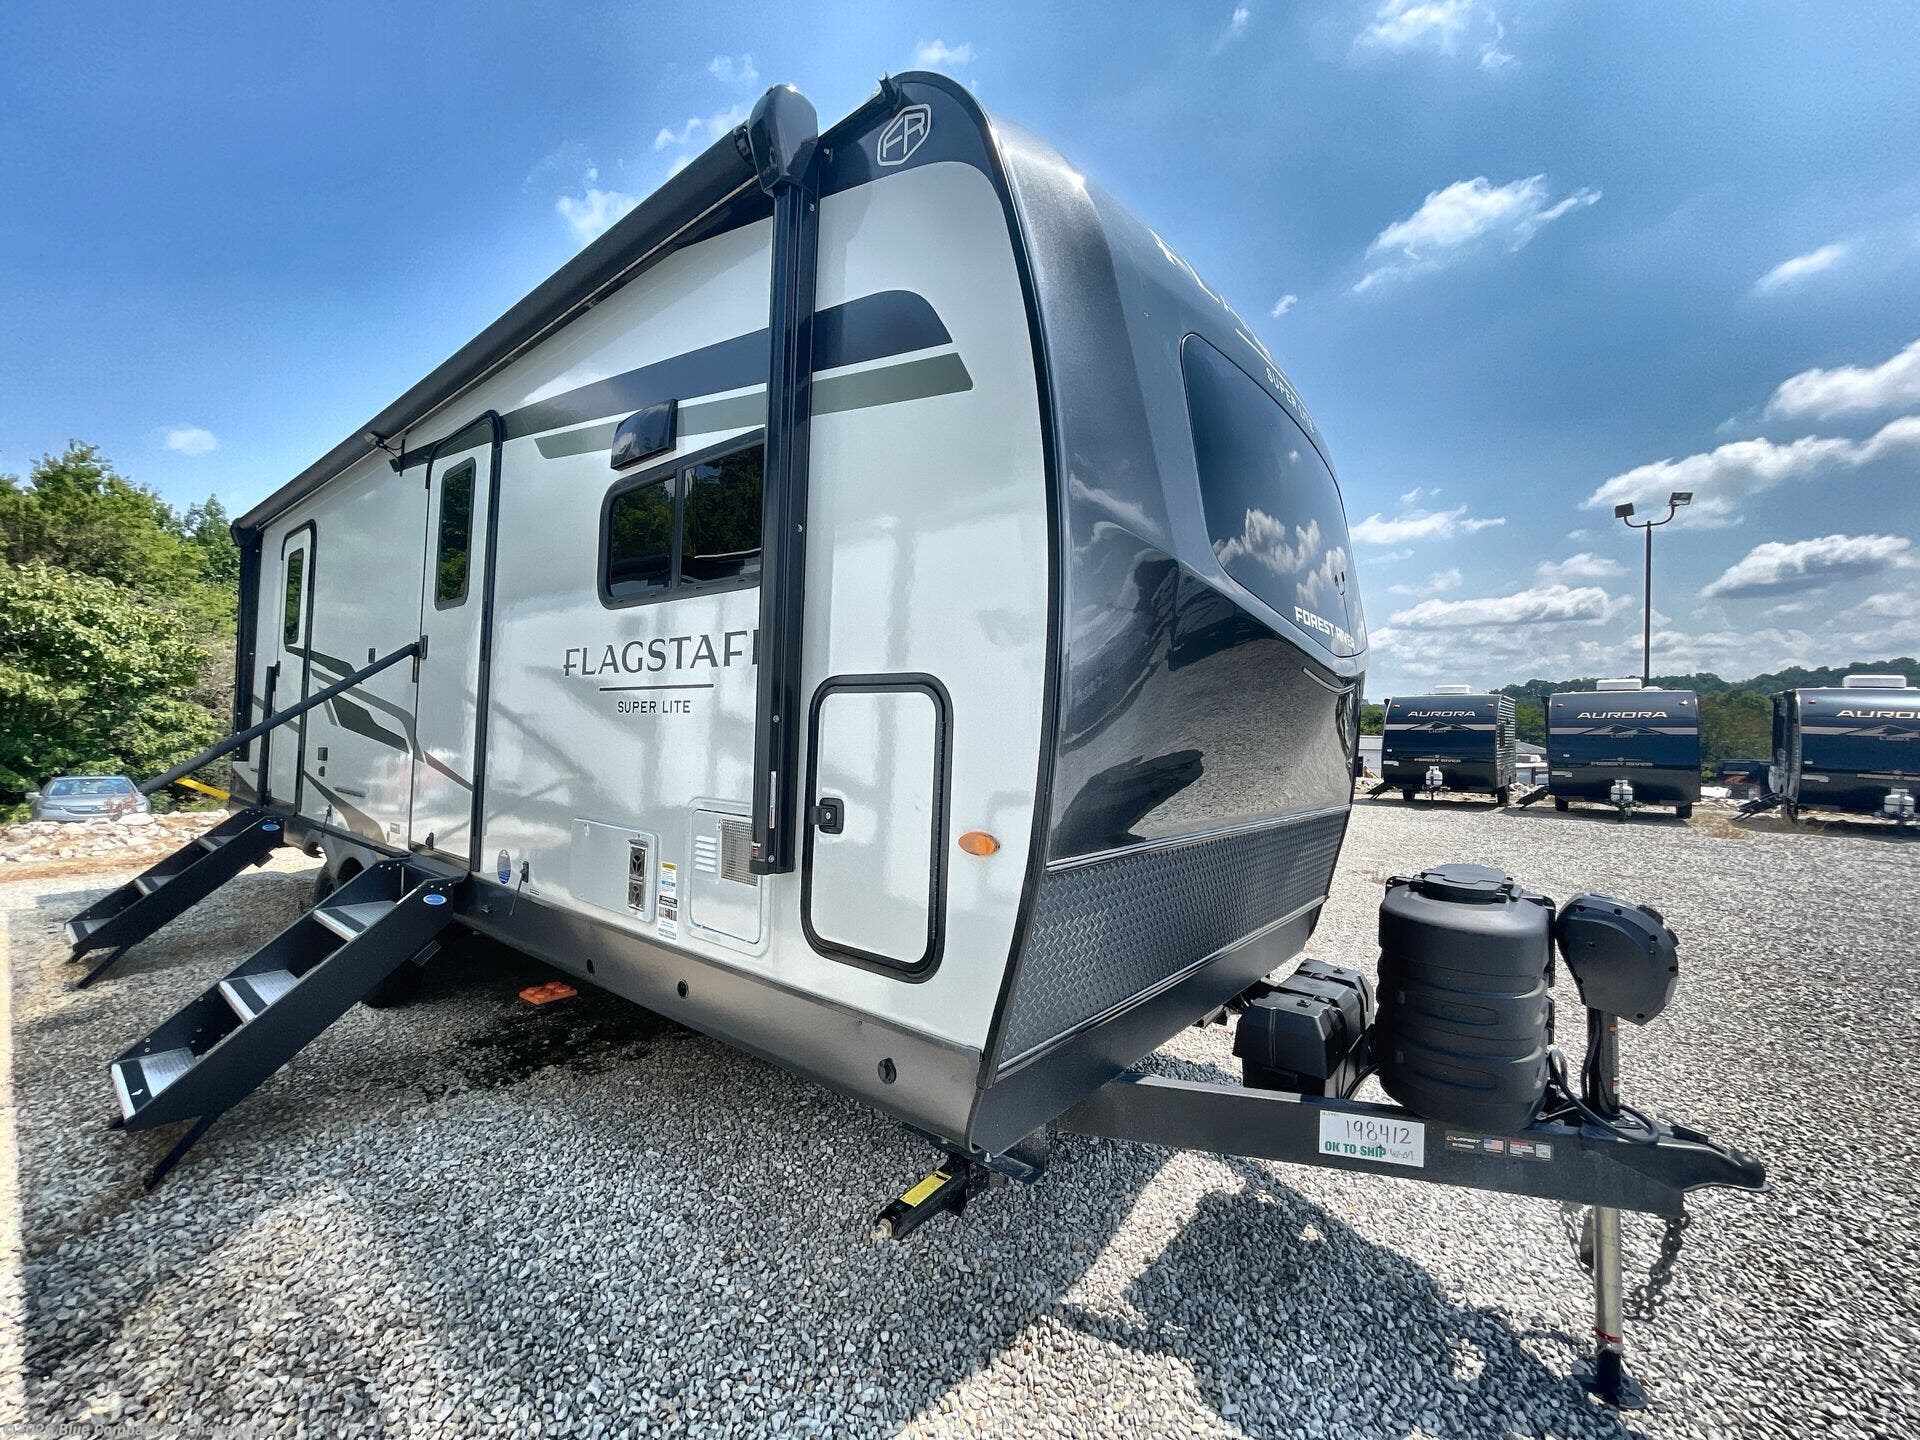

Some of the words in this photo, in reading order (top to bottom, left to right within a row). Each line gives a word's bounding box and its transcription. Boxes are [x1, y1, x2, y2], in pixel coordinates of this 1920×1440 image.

[1265, 367, 1298, 411] SUPER
[1294, 606, 1335, 637] FOREST
[618, 701, 657, 714] SUPER
[662, 700, 691, 714] LITE
[1577, 711, 1668, 719] AURORA
[1837, 710, 1920, 719] AURO
[1346, 1120, 1411, 1144] 198412
[1325, 1141, 1340, 1152] OK
[1343, 1143, 1357, 1154] TO
[1360, 1145, 1386, 1158] SHIP
